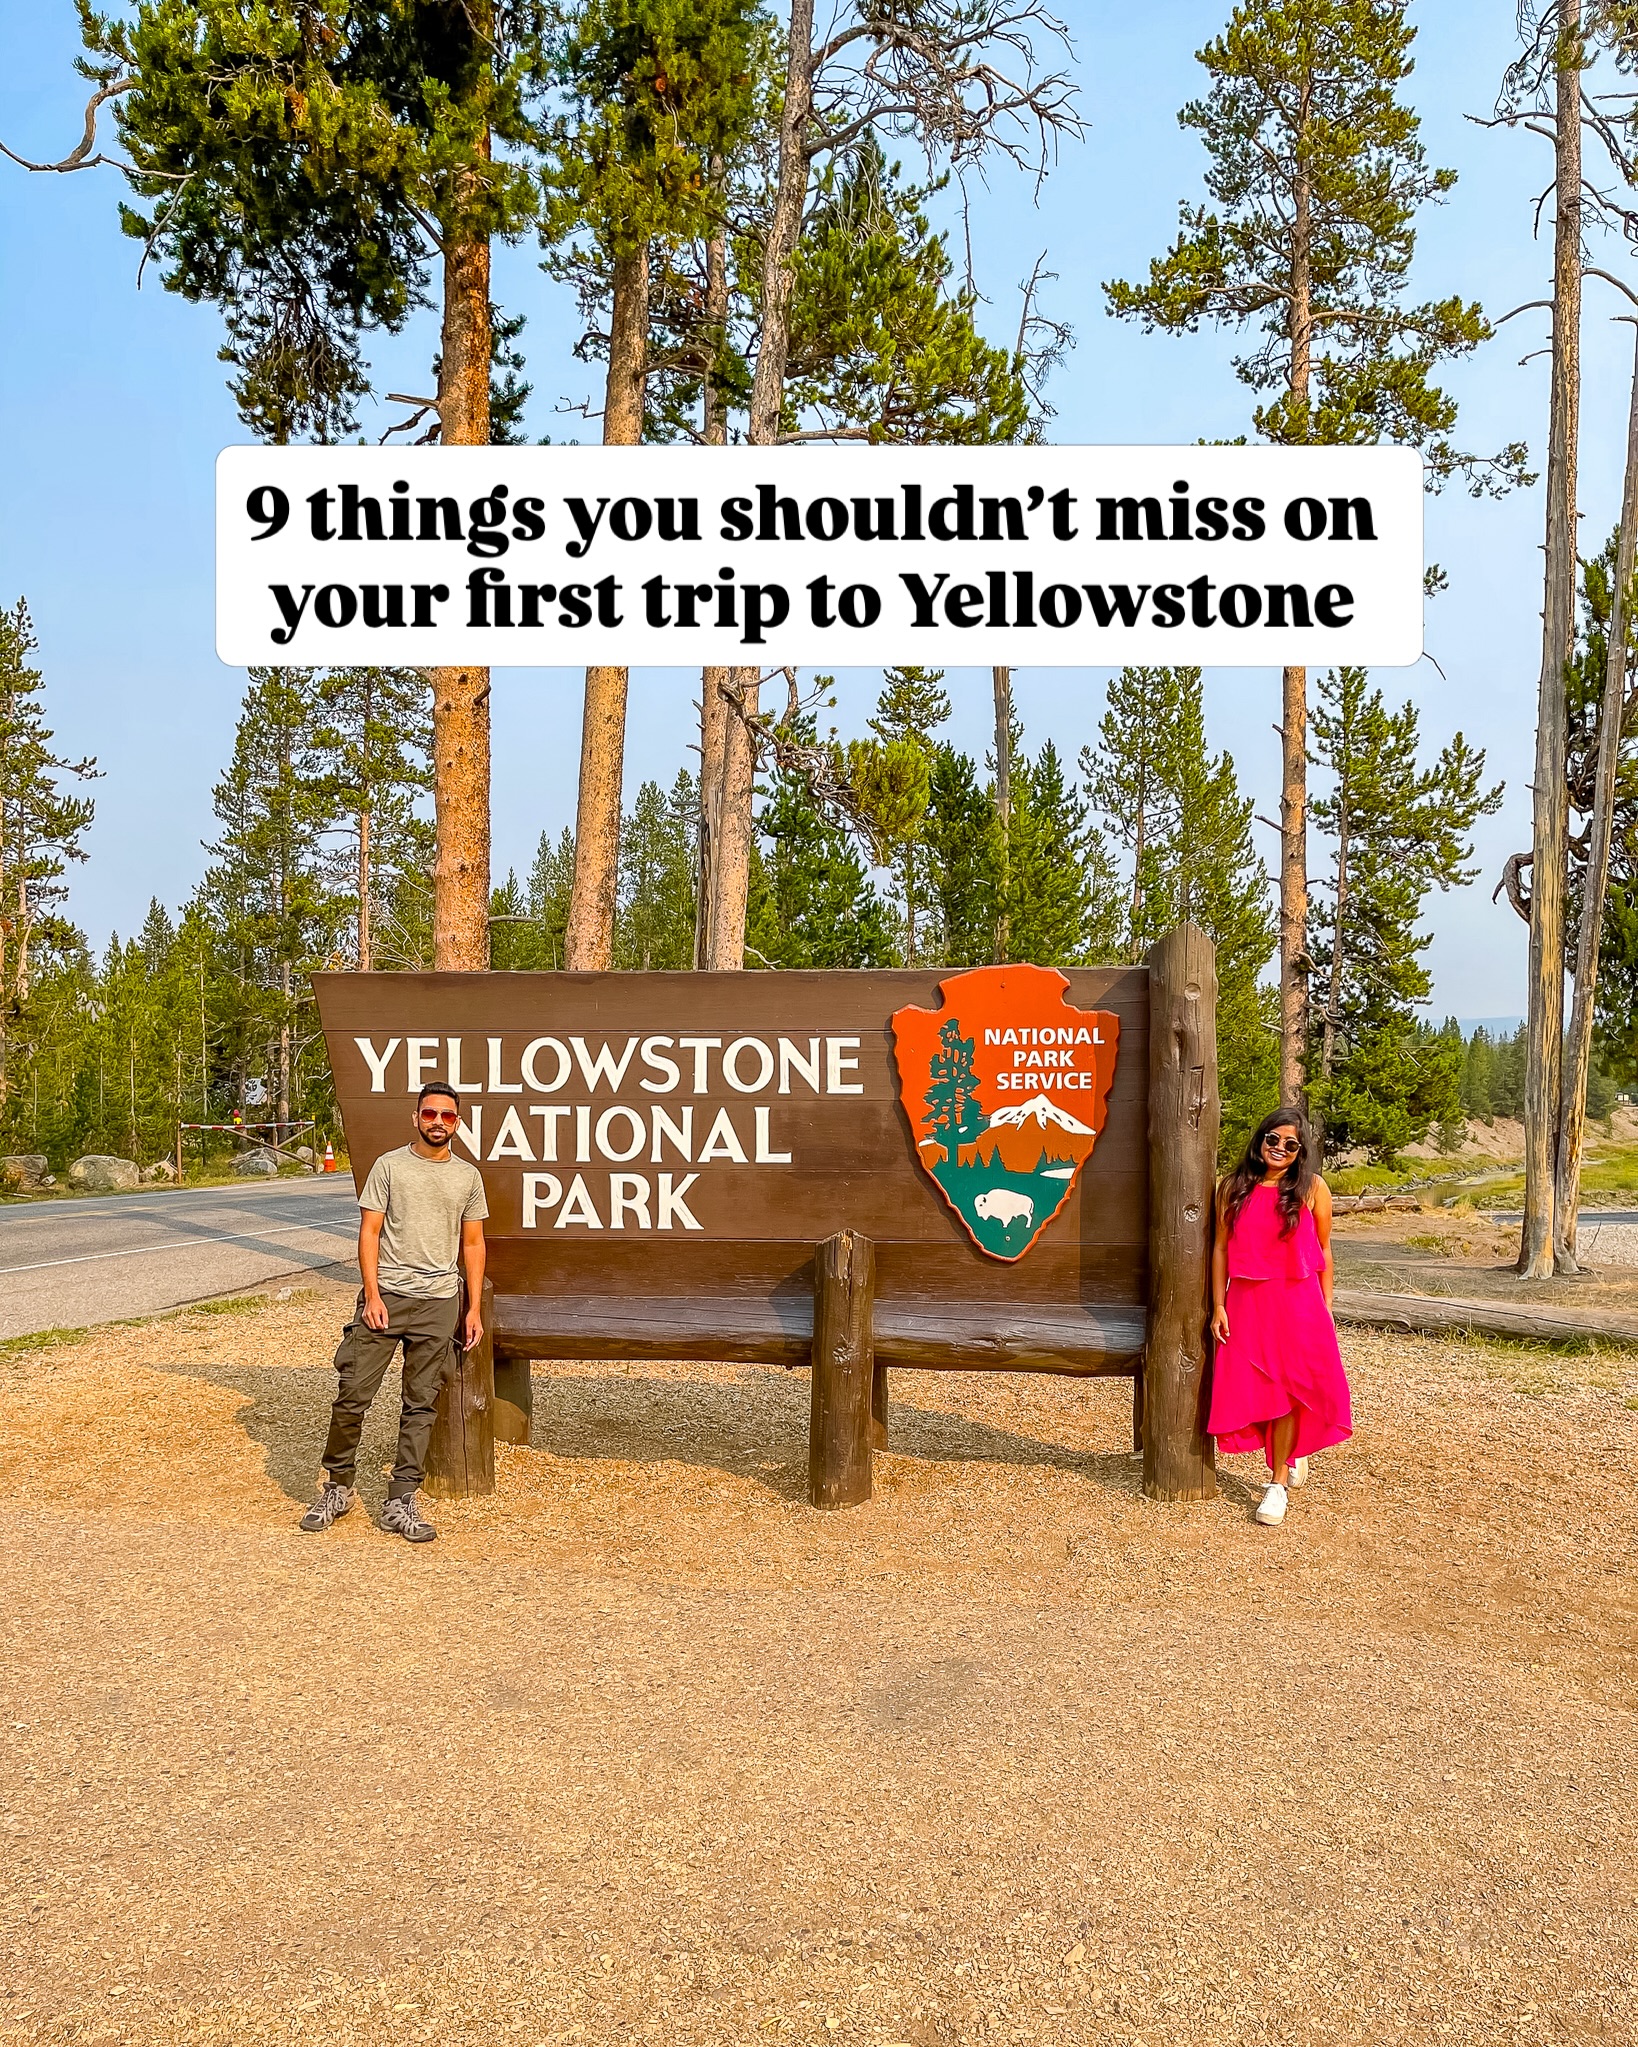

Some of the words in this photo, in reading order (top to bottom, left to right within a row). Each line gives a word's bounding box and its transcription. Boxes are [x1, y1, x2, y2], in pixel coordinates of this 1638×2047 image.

[984, 1027, 1106, 1046] NATIONAL
[353, 1035, 864, 1095] YELLOWSTONE
[1013, 1050, 1075, 1068] PARK
[996, 1072, 1093, 1091] SERVICE
[522, 1172, 705, 1231] PARK
